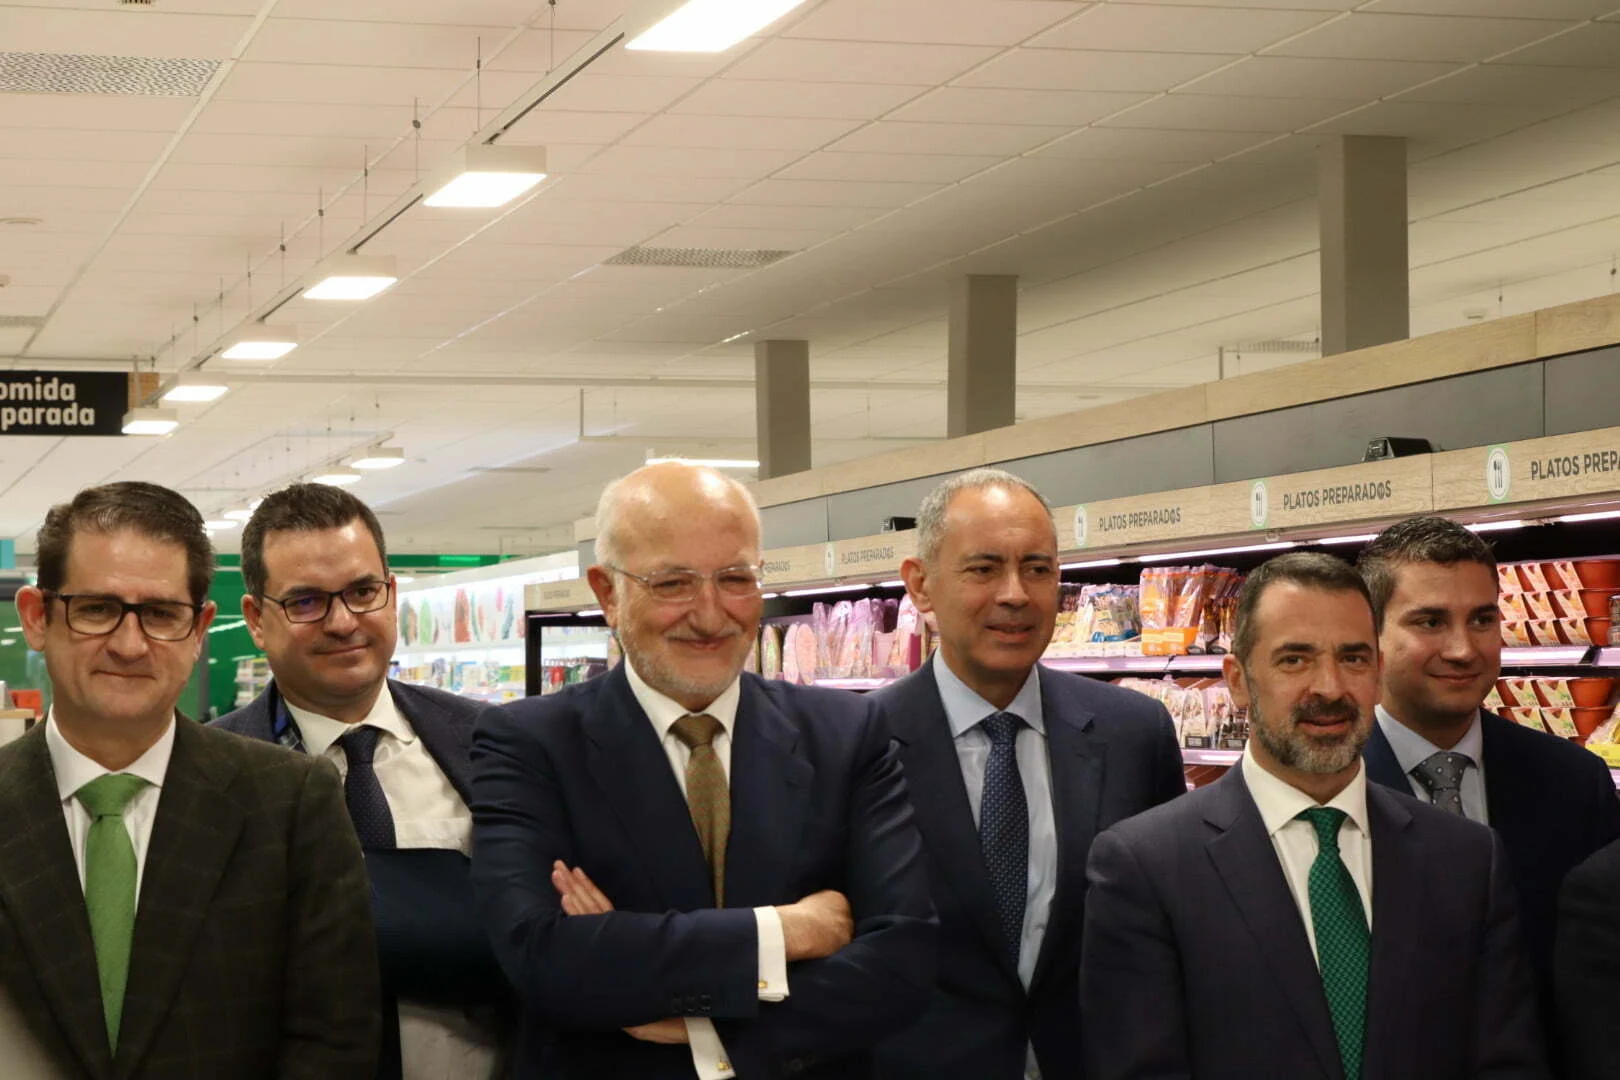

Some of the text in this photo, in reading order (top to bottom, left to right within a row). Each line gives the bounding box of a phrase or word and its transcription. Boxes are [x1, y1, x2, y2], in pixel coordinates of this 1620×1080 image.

[0, 376, 76, 401] omida
[1, 402, 95, 431] parada
[1531, 450, 1620, 480] PLATOS PREP
[1283, 480, 1392, 511] PLATOS PREPARADOS
[1099, 507, 1181, 532] PLATOS PREPARADOS
